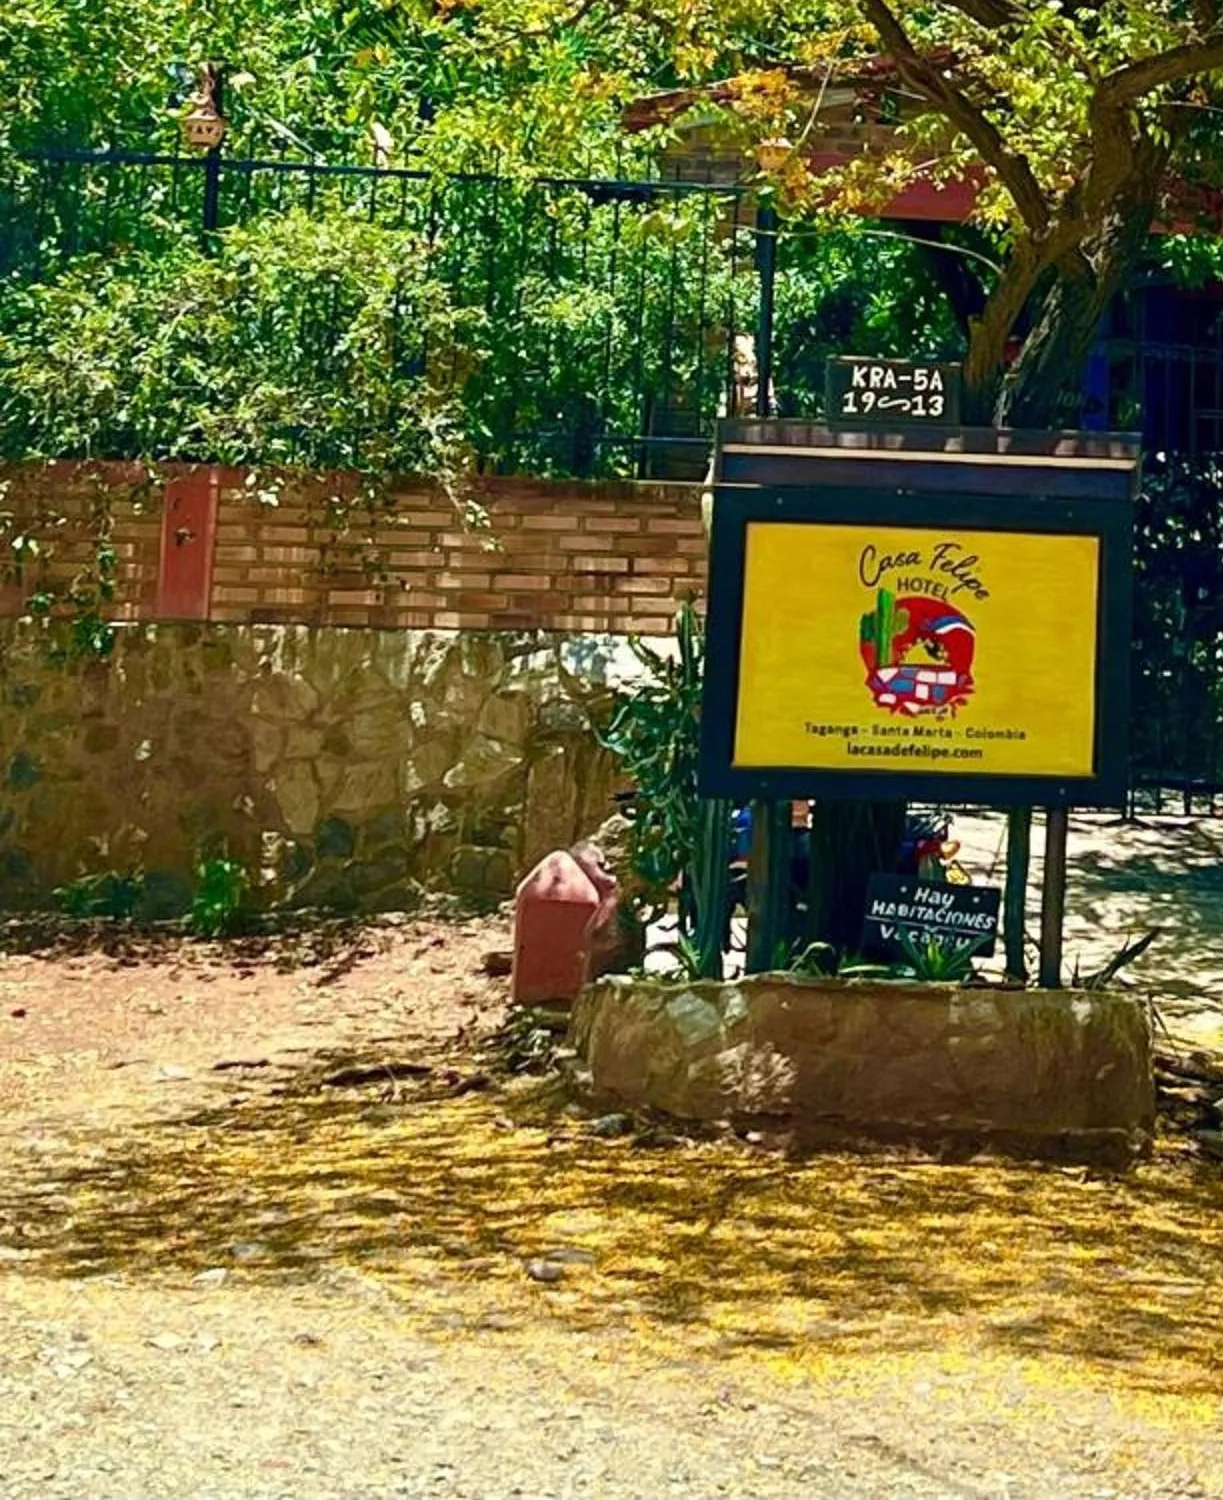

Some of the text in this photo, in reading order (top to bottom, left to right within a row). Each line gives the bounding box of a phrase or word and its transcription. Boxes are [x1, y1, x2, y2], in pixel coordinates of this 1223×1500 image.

[852, 365, 943, 391] KRA-5A
[859, 542, 990, 600] Casa Felipe
[897, 577, 949, 598] HOTEL
[804, 721, 858, 738] Taganga
[872, 724, 910, 737] Santa
[913, 725, 952, 738] Marta
[966, 727, 1026, 740] Colombia
[847, 741, 983, 760] lacasadefelipe.com
[914, 887, 955, 909] Hay
[871, 900, 996, 930] HABITACIONES
